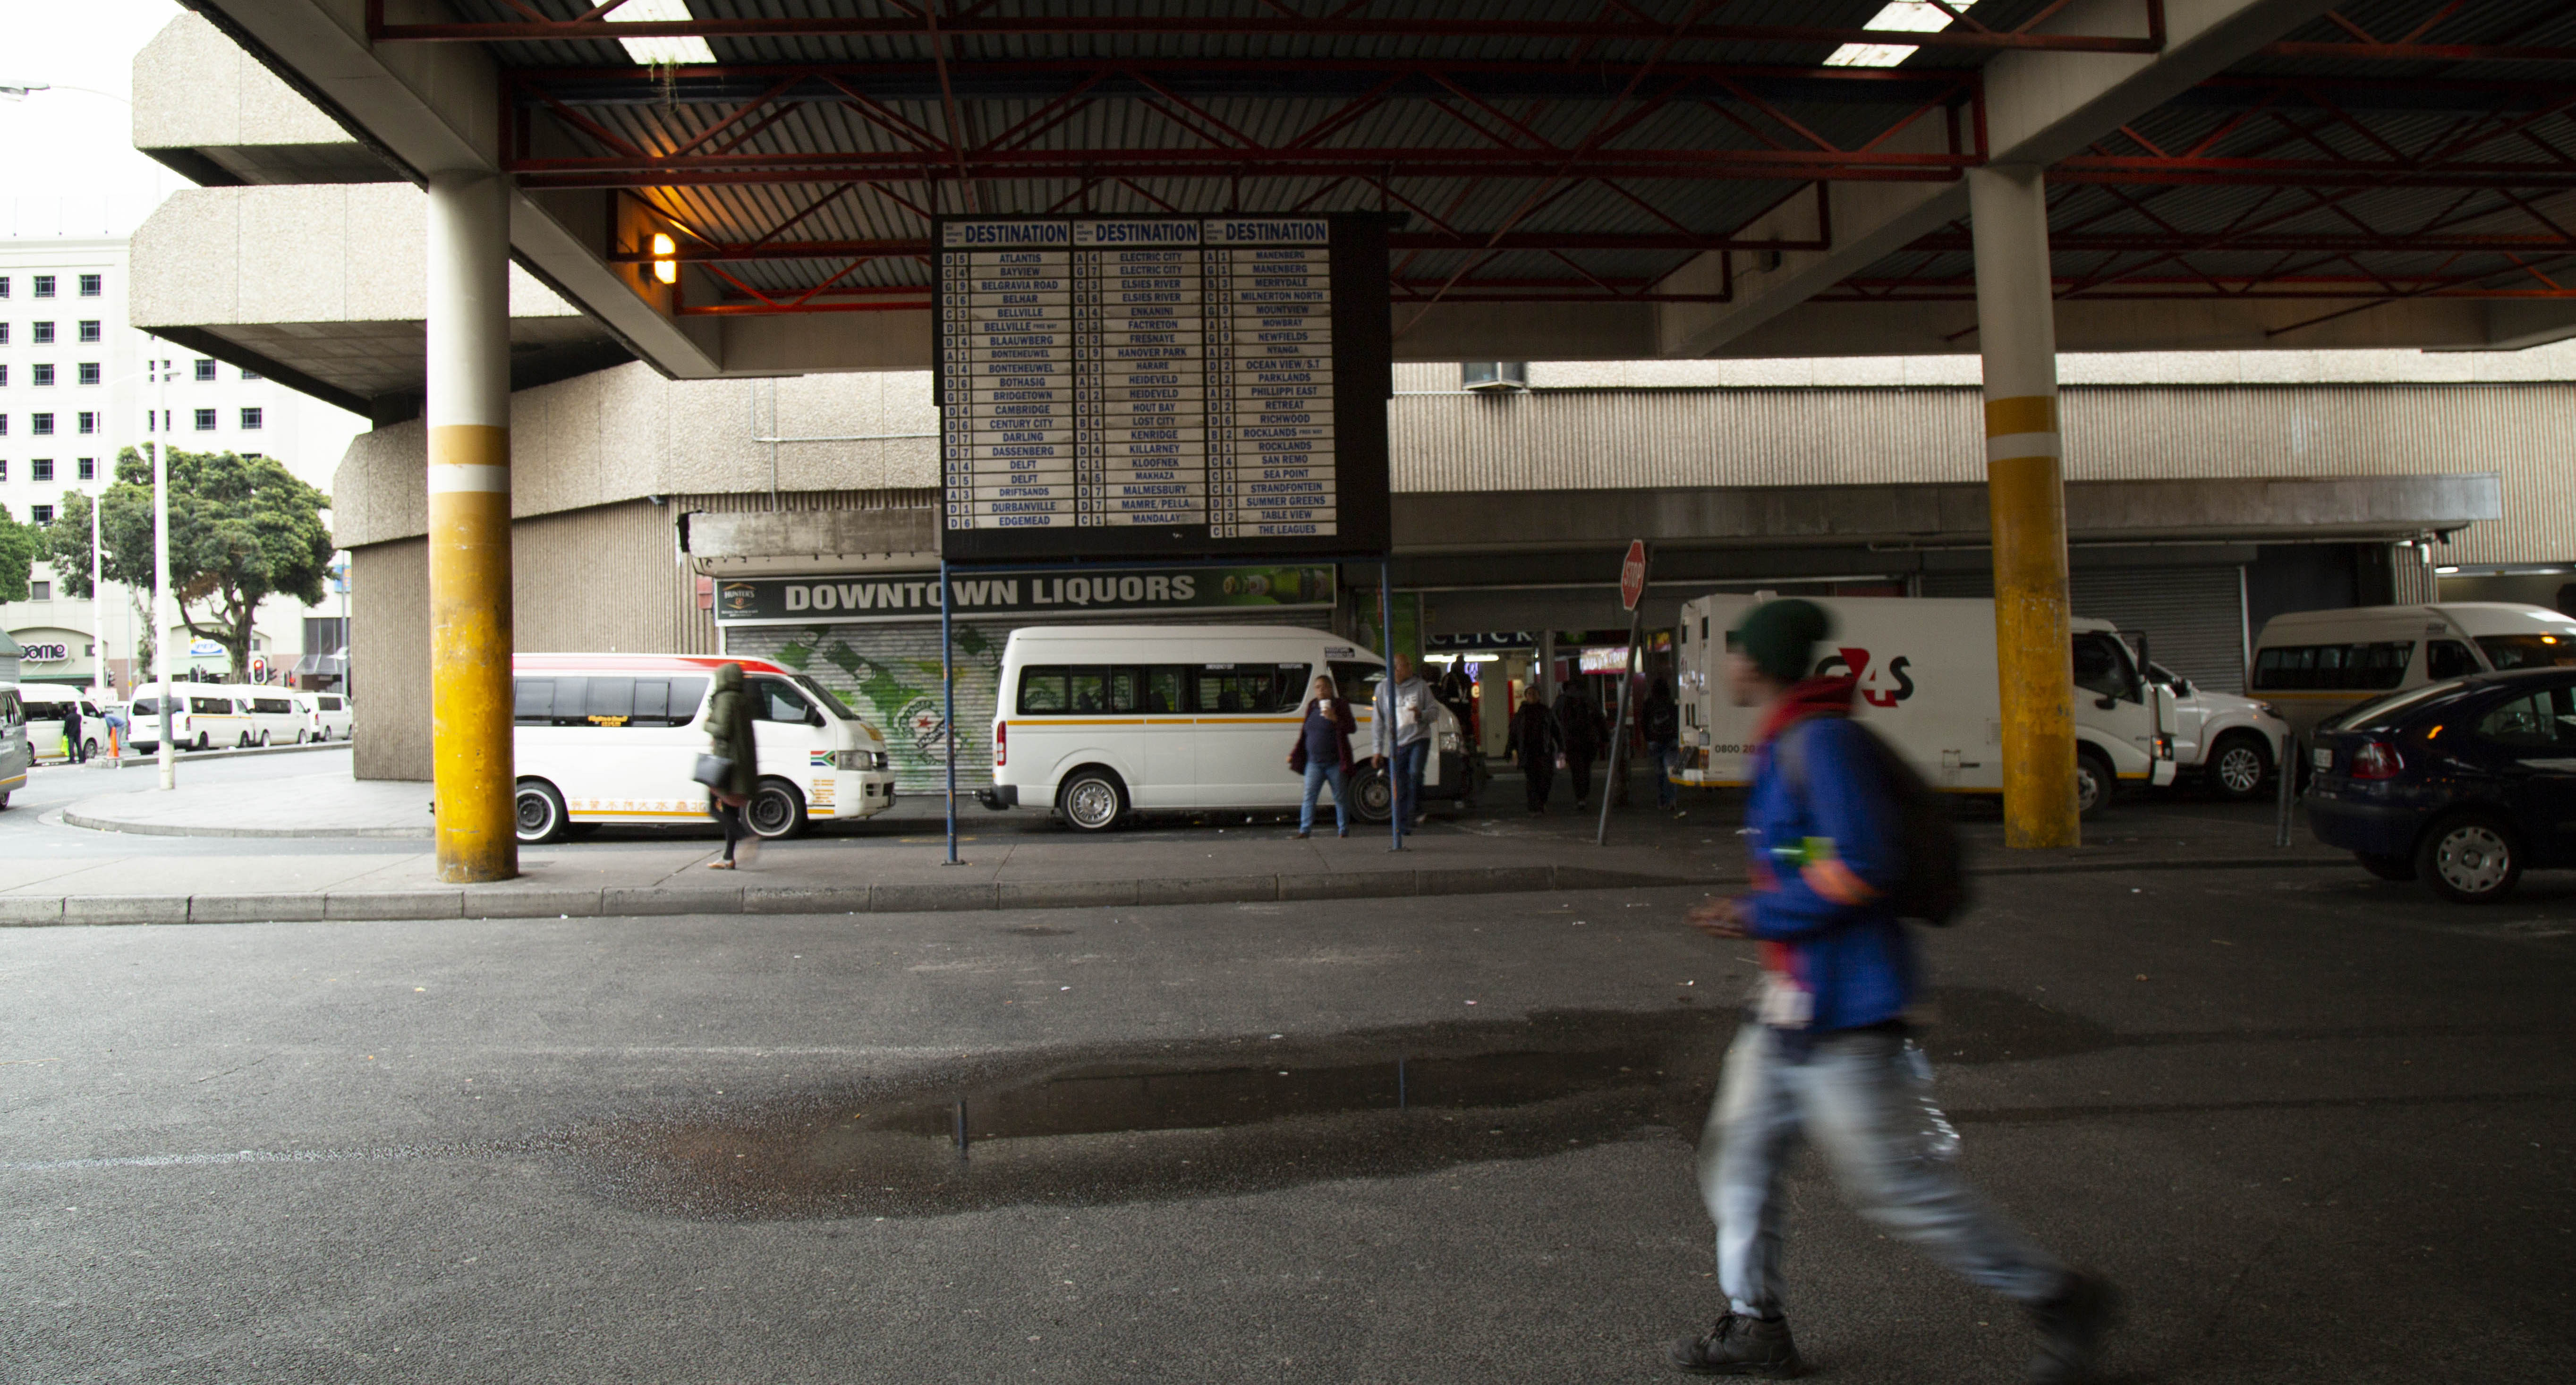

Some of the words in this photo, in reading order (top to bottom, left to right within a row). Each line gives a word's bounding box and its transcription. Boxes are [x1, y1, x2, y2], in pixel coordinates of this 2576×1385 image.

[966, 225, 1067, 242] DESTINATION
[1097, 223, 1196, 241] DESTINATION
[1226, 223, 1326, 240] DESTINATION
[1000, 255, 1041, 263] ATLANTIS
[1120, 253, 1160, 262] ELECTRIC
[1163, 253, 1182, 261] CITY
[1001, 268, 1040, 276] BAYVIEW
[1120, 266, 1160, 274] ELECTRIC
[1163, 266, 1182, 274] CITY
[1253, 264, 1307, 273] MANENBERG
[1122, 280, 1151, 289] ELSIES
[1155, 280, 1180, 288] RIVER
[1256, 279, 1307, 287] MERRYDALE
[946, 296, 952, 305] G
[1003, 295, 1038, 303] BELHAR
[1123, 293, 1152, 302] ELSIES
[1155, 293, 1181, 301] RIVER
[1241, 292, 1291, 300] MILNERTON
[946, 310, 952, 318] C
[998, 308, 1043, 317] BELLVILLE
[1257, 306, 1309, 314] MOUNTVIEW
[985, 323, 1031, 331] BELLVILLE
[1129, 321, 1178, 330] FACTRETON
[1263, 319, 1303, 327] MOWBRAY
[990, 336, 1053, 345] BLAAUWBERG
[1131, 335, 1175, 343] FRESNAYE
[1259, 332, 1308, 341] NEWFIELDS
[947, 352, 953, 360] A
[961, 352, 966, 360] 1
[992, 350, 1049, 358] BONTEHEUWEL
[1119, 348, 1160, 357] HANOVER
[1164, 348, 1186, 356] PARK
[961, 365, 967, 373] 4
[989, 364, 1054, 373] BONTEHEUWEL
[1137, 362, 1169, 370] HARARE
[1247, 361, 1276, 369] OCEAN
[1000, 378, 1045, 386] BOTHASIG
[1130, 375, 1178, 384] HEIDEVELD
[1259, 374, 1310, 382] PARKLANDS
[994, 391, 1052, 400] BRIDGETOWN
[1130, 389, 1178, 398] HEIDEVELD
[1252, 387, 1293, 396] PHILLIPPI
[1297, 387, 1317, 395] EAST
[1133, 404, 1156, 412] HOUT
[1159, 403, 1176, 411] BAY
[1266, 401, 1304, 409] RETREAT
[950, 408, 955, 416] D
[995, 405, 1050, 414] CAMBRIDGE
[962, 421, 968, 429] 6
[990, 419, 1030, 428] CENTURY
[1034, 419, 1053, 427] CITY
[1157, 417, 1175, 425] CITY
[1260, 415, 1310, 424] RICHWOOD
[1131, 431, 1178, 439] KENRIDGE
[1244, 428, 1296, 437] ROCKLANDS
[950, 435, 955, 443] D
[1003, 433, 1043, 441] DARLING
[1080, 446, 1086, 455] D
[1094, 446, 1099, 454] 4
[1130, 445, 1180, 453] KILLARNEY
[1259, 442, 1311, 450] ROCKLANDS
[993, 447, 1054, 456] DASSENBERG
[1080, 460, 1086, 468] C
[1095, 460, 1099, 468] 1
[1133, 459, 1179, 467] KLOOFNEK
[1262, 456, 1279, 464] SAN
[1283, 455, 1308, 463] REMO
[950, 463, 955, 471] A
[1011, 460, 1037, 469] DELFT
[1264, 470, 1280, 478] SEA
[1284, 469, 1309, 478] POINT
[1012, 475, 1037, 484] DELFT
[1082, 488, 1087, 496] D
[1096, 488, 1101, 496] 7
[1124, 485, 1187, 494] MALMESBURY
[1251, 483, 1322, 493] STRANDFONTEIN
[951, 491, 956, 499] A
[964, 491, 969, 499] 3
[1000, 488, 1049, 497] DRIFTSANDS
[1082, 502, 1088, 510] D
[1096, 501, 1101, 510] 7
[1247, 497, 1286, 506] SUMMER
[1290, 496, 1326, 505] GREENS
[964, 505, 969, 513] 1
[992, 502, 1056, 511] DURBANVILLE
[1081, 516, 1088, 524] C
[1133, 514, 1181, 523] MANDALAY
[1262, 511, 1286, 519] TABLE
[1290, 510, 1312, 519] VIEW
[952, 519, 957, 527] D
[964, 519, 970, 527] 6
[1000, 516, 1050, 525] EDGEMEAD
[1259, 526, 1275, 534] THE
[1277, 525, 1316, 534] LEAGUES
[1624, 561, 1643, 588] STOP
[785, 580, 1018, 610] DOWNTOWN
[1032, 575, 1195, 605] LIQUORS
[1427, 631, 1537, 645] CLICK
[1715, 744, 1739, 753] 0800
[1743, 744, 1755, 754] 20
